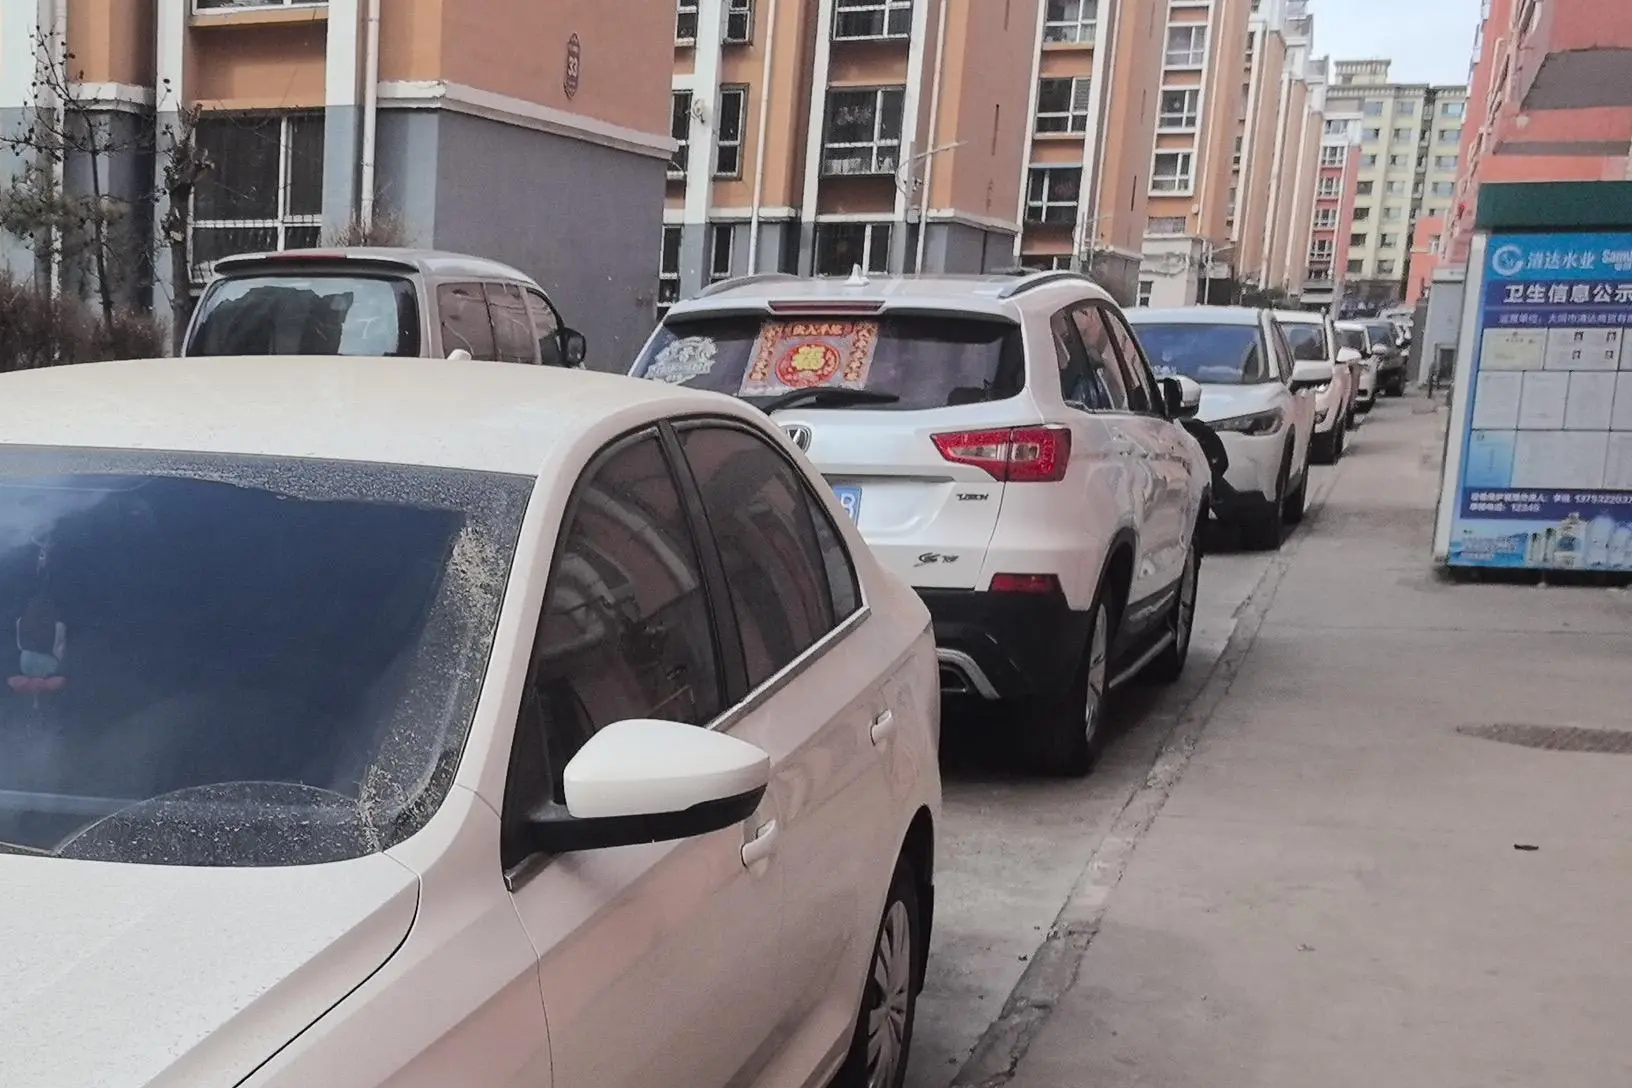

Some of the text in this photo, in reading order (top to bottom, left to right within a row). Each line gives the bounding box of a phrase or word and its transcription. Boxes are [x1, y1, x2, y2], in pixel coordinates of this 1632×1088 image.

[1502, 282, 1632, 303] 卫生信息公示
